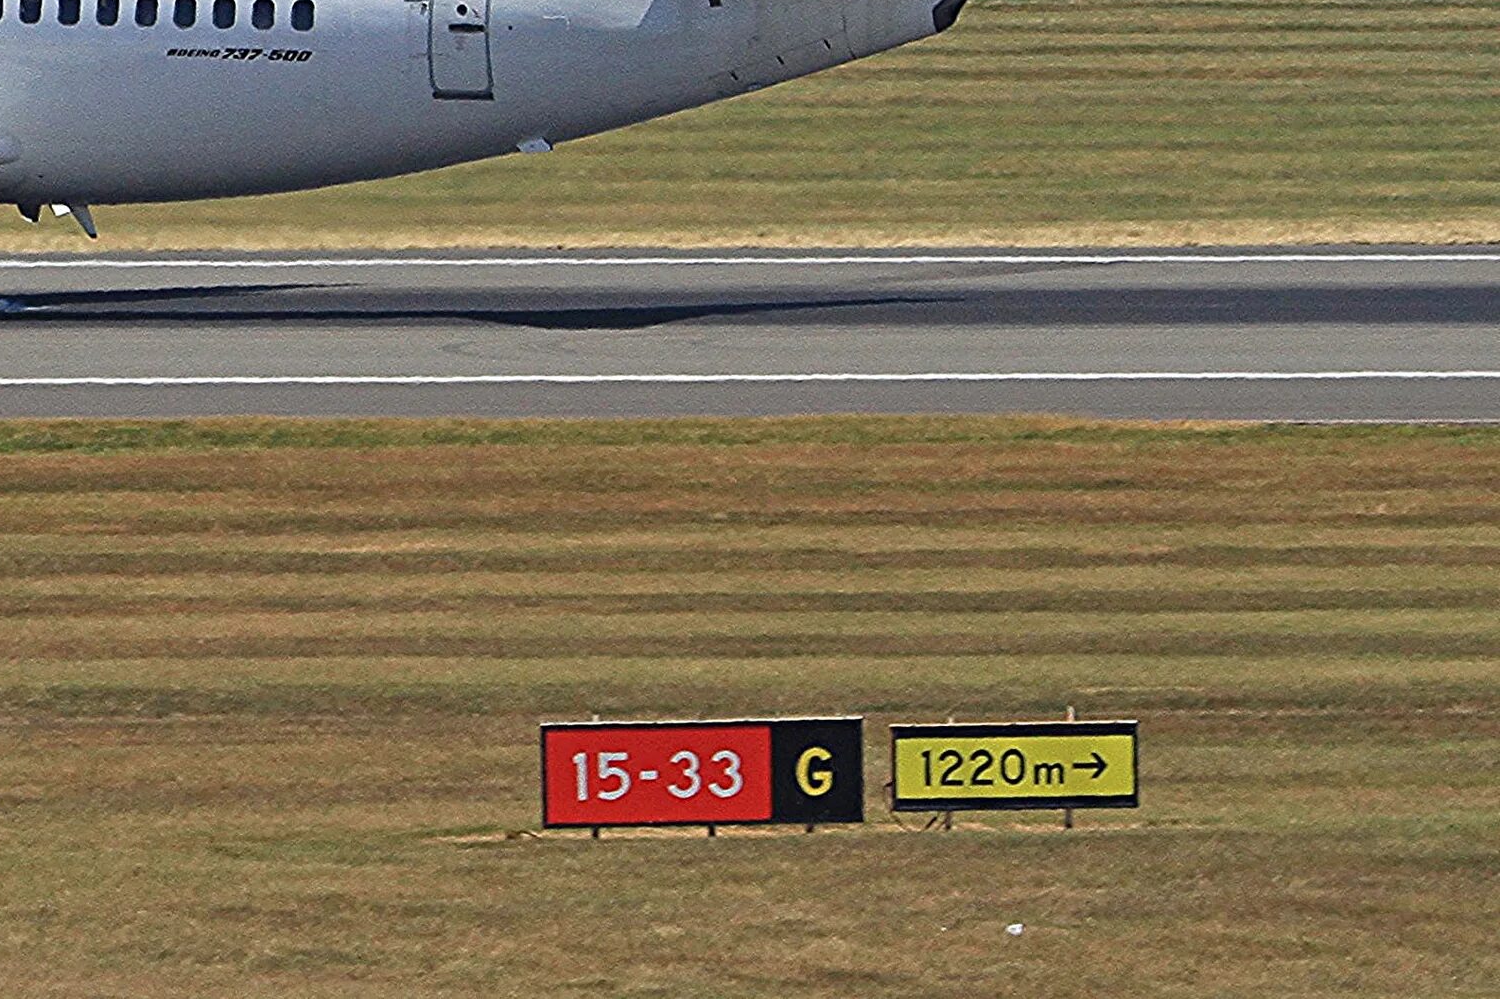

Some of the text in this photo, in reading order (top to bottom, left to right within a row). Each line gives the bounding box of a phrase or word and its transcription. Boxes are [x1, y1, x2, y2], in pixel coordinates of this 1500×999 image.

[166, 47, 313, 62] BOEING 737-500
[572, 746, 834, 801] 15-33 G
